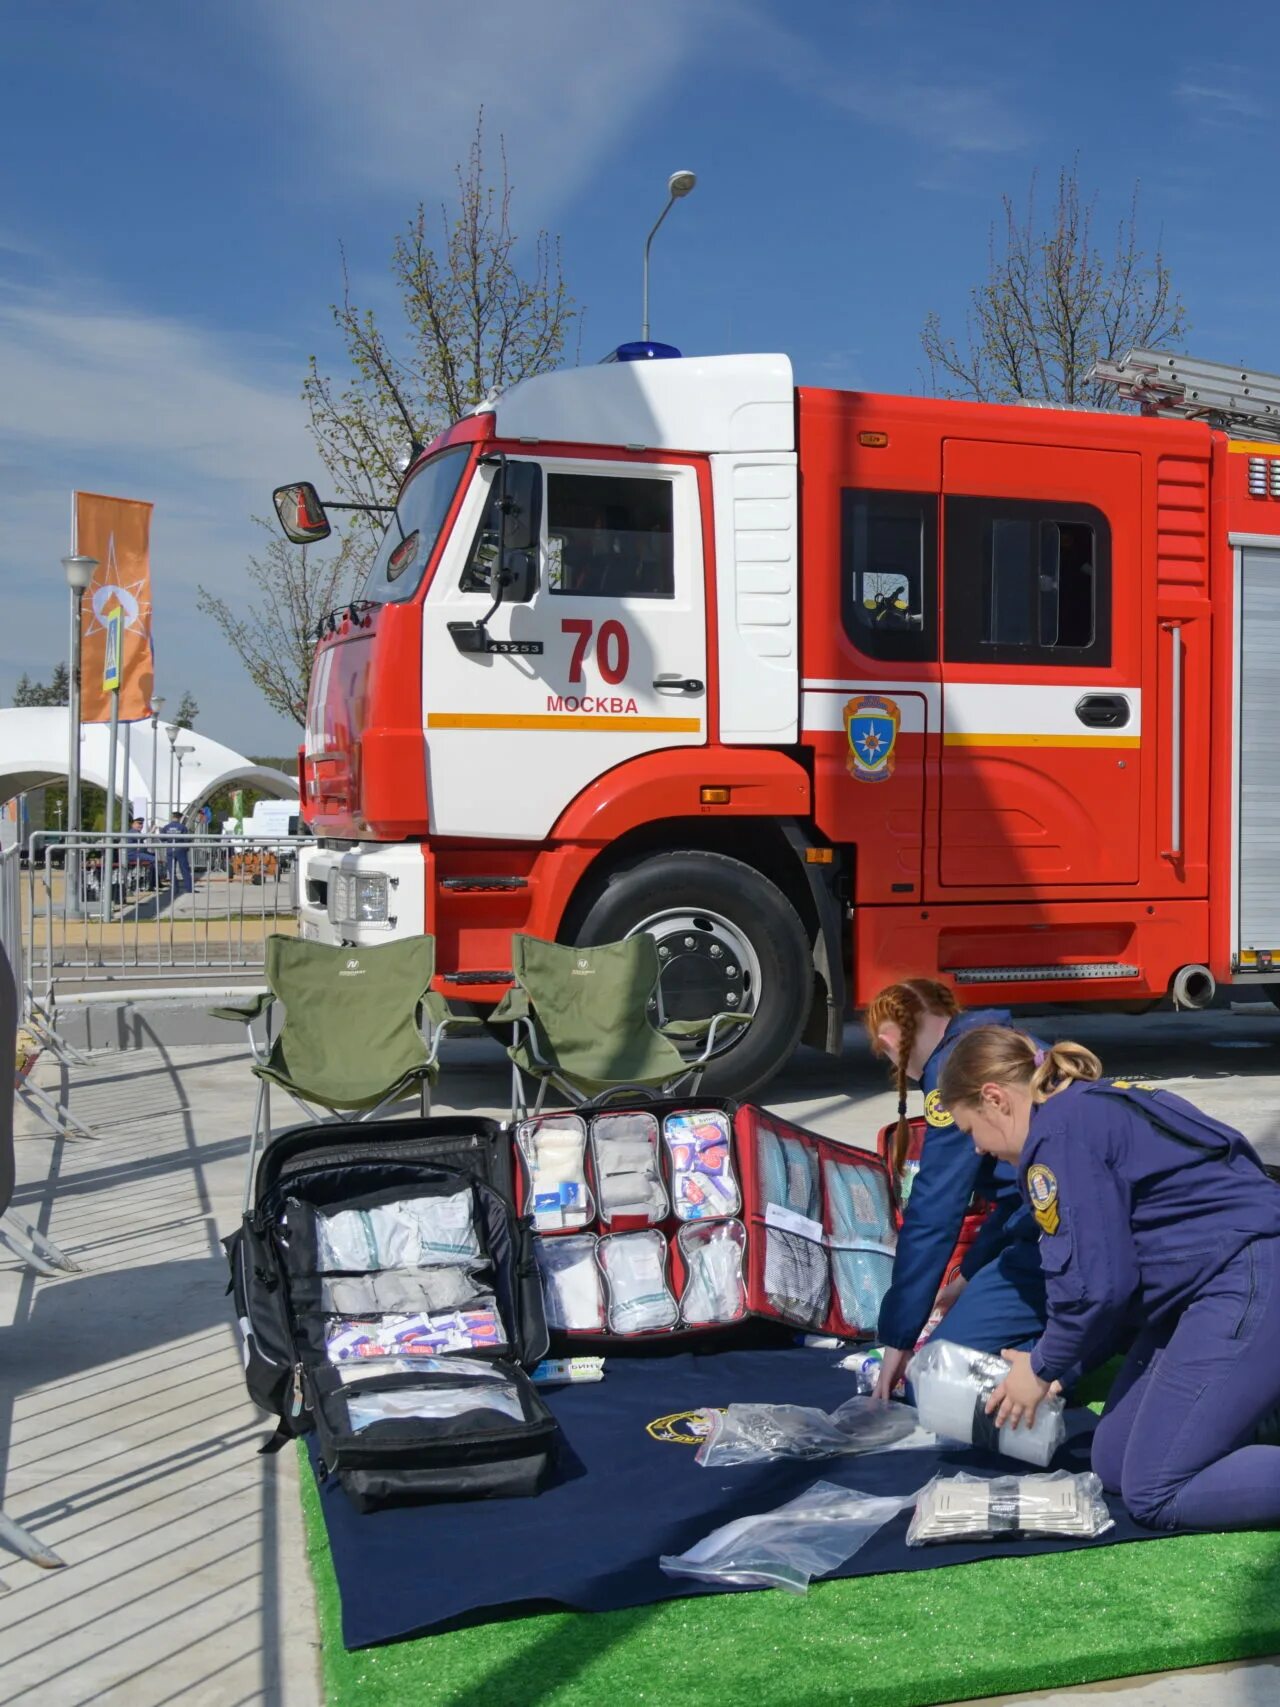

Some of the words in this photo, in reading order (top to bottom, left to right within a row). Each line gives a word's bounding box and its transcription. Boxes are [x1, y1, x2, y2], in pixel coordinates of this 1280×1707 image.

[489, 643, 540, 654] 43253
[561, 618, 630, 685] 70
[546, 695, 639, 714] МОСКВА
